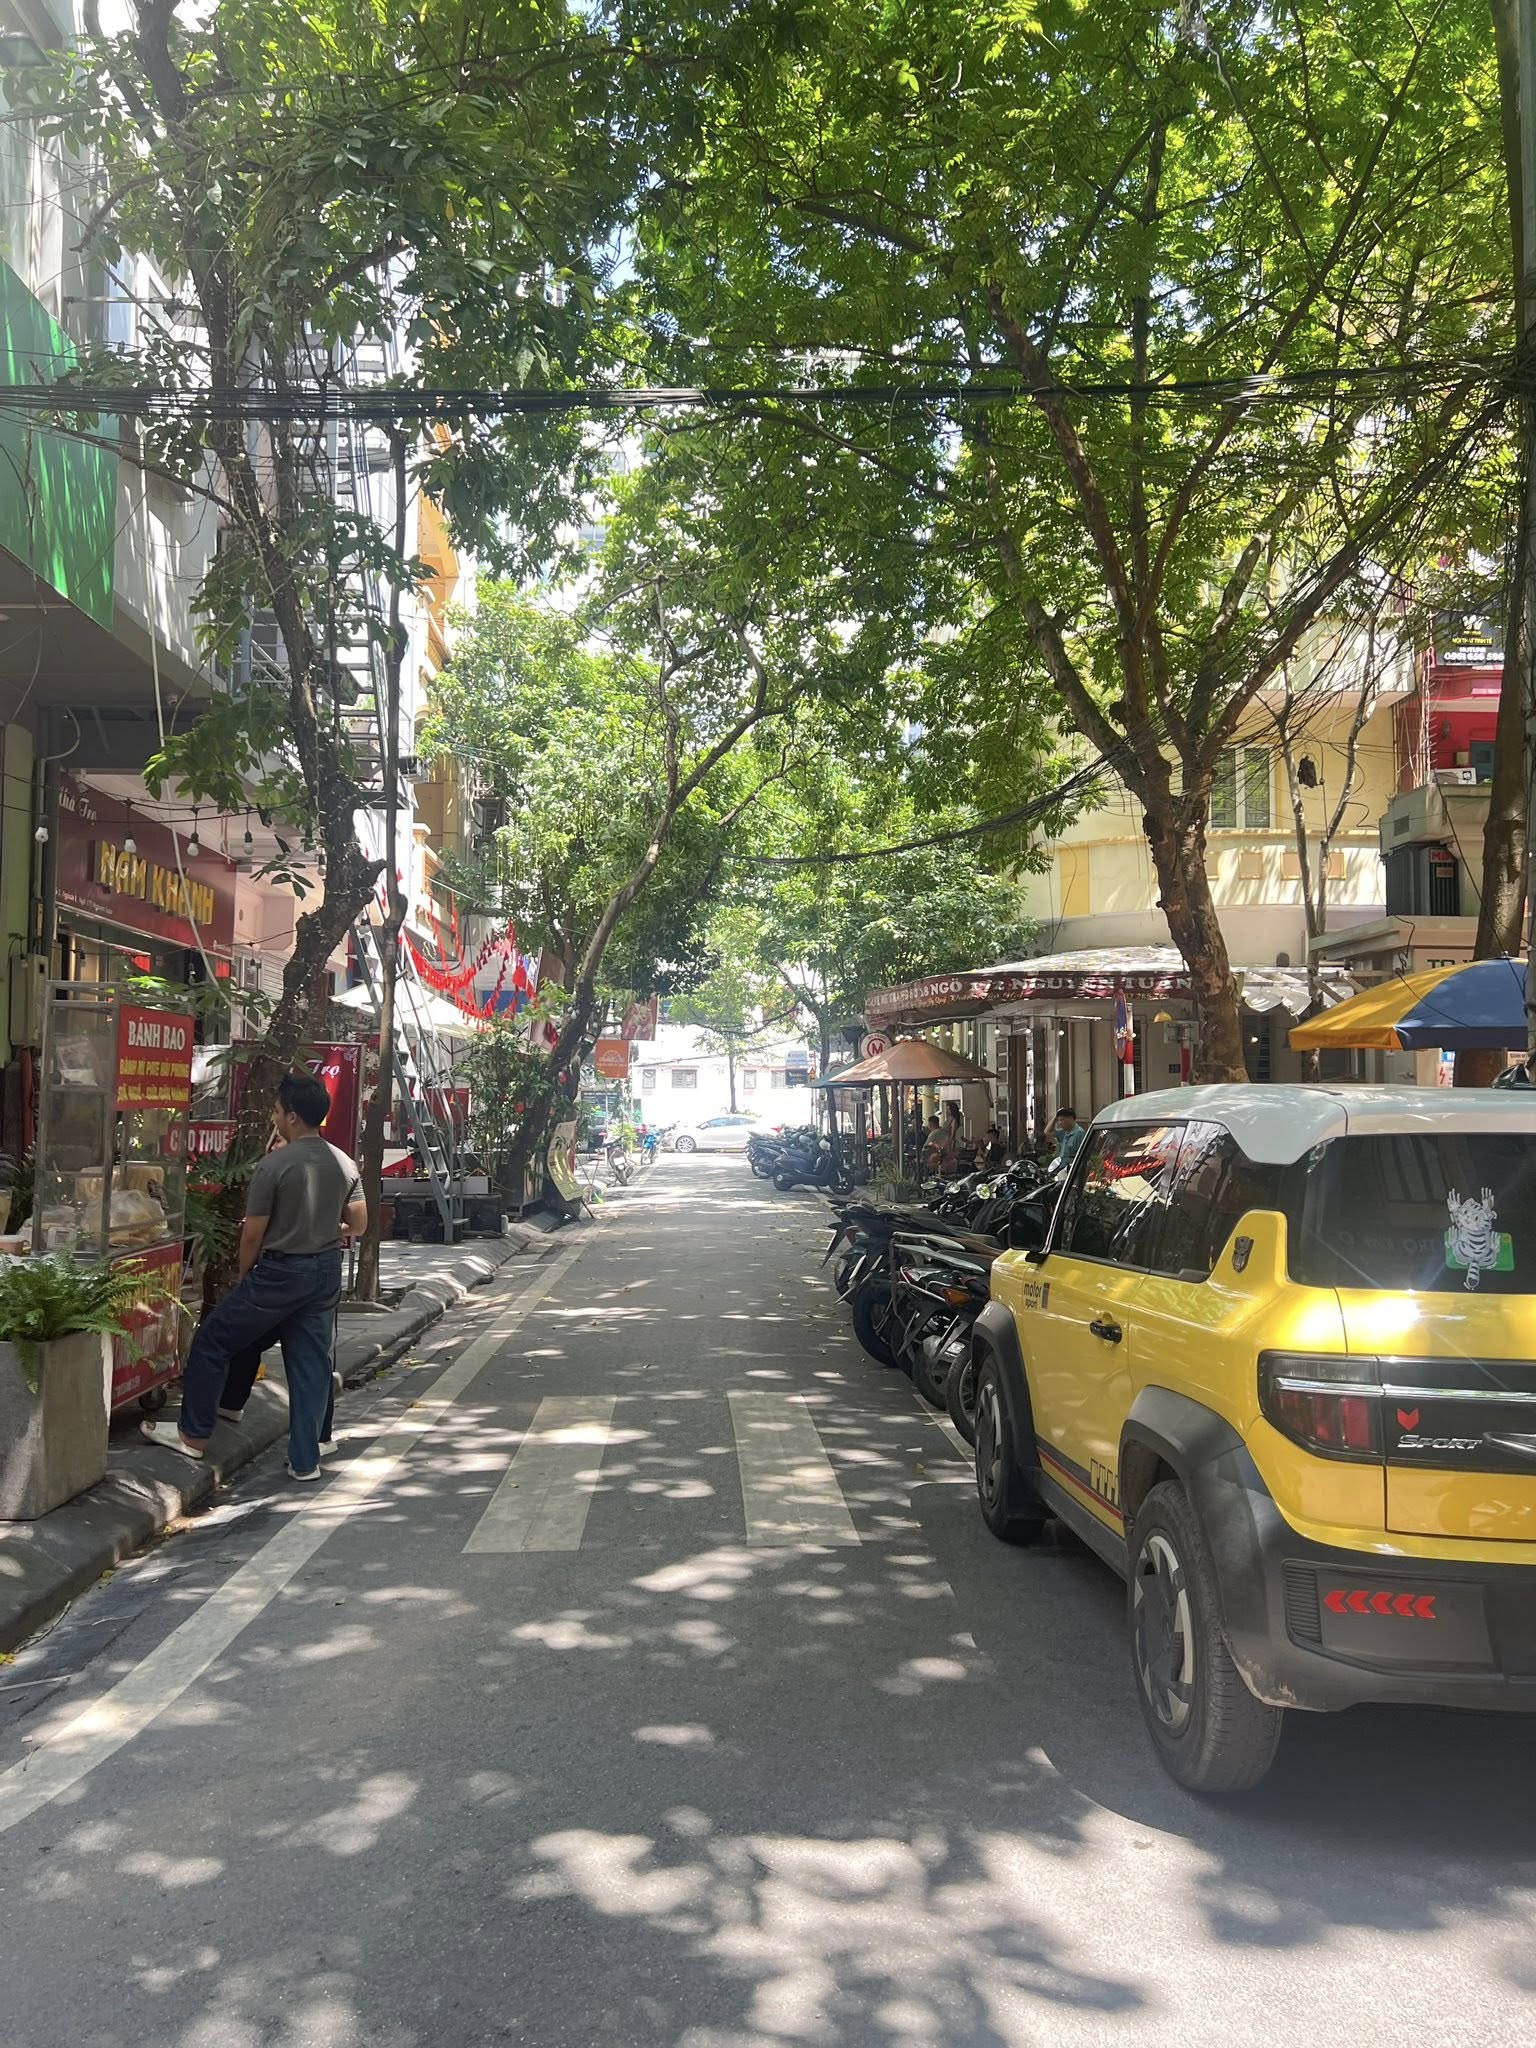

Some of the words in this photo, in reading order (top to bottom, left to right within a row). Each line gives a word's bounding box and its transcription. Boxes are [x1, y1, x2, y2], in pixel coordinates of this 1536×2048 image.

[100, 840, 147, 899] NAM
[152, 864, 214, 925] KHÁNH
[128, 1016, 160, 1048] BÁNH
[163, 1025, 185, 1051] BAO
[305, 1059, 341, 1079] Trọ
[200, 1126, 230, 1152] THUÊ
[1024, 1281, 1042, 1298] motor
[1025, 1298, 1038, 1309] sport
